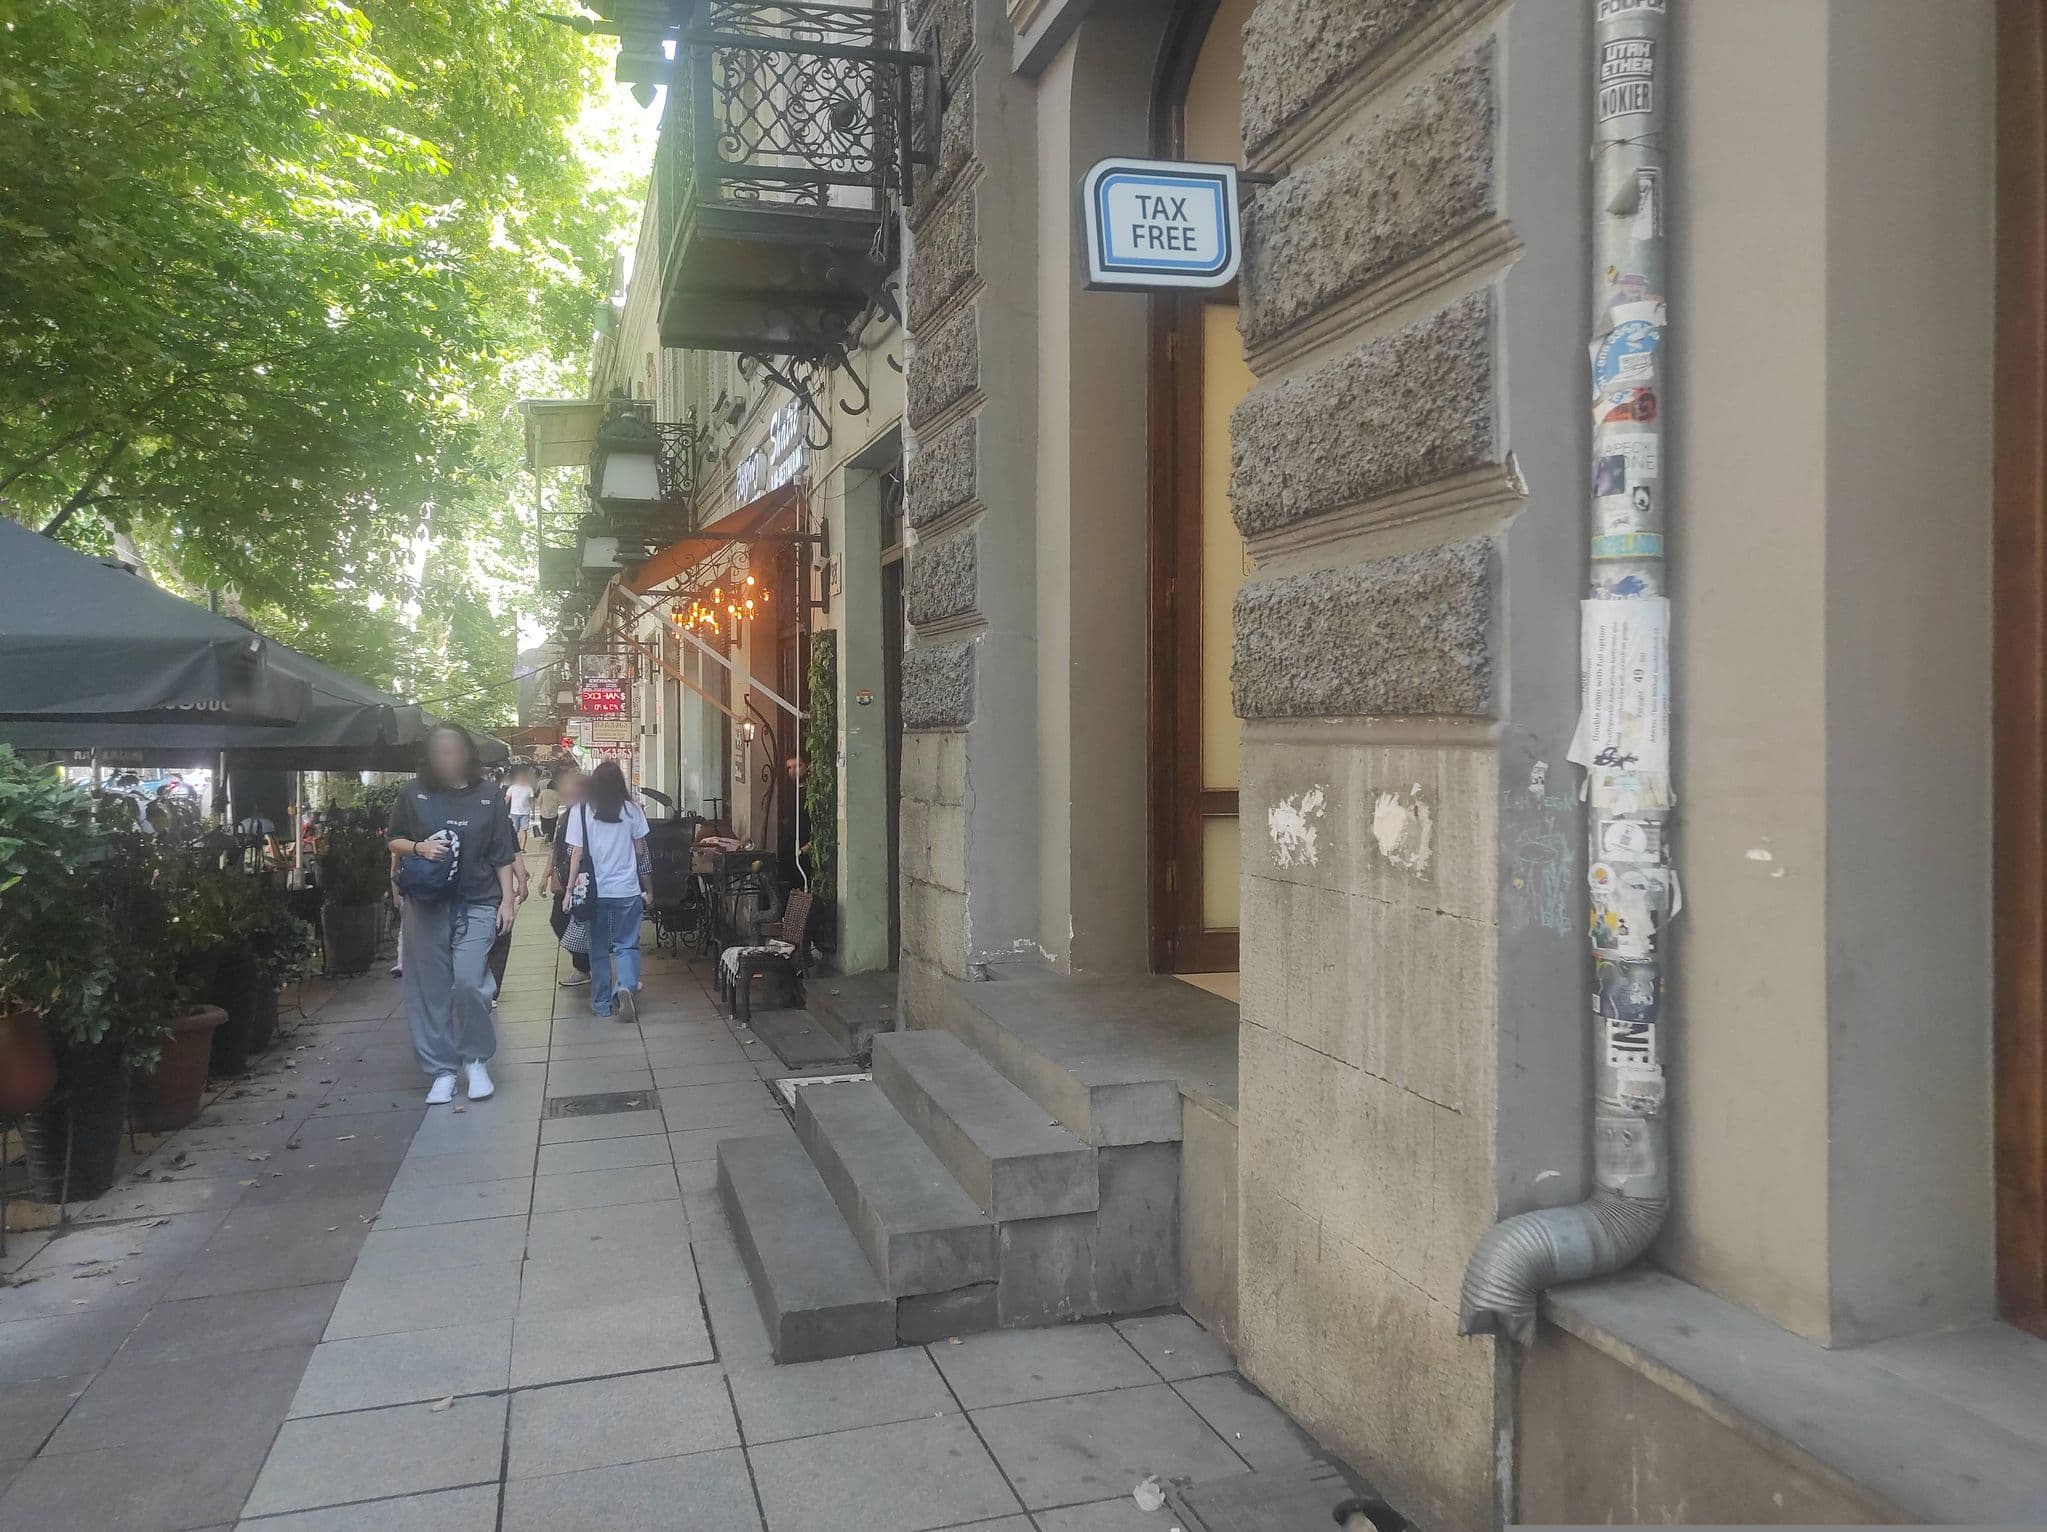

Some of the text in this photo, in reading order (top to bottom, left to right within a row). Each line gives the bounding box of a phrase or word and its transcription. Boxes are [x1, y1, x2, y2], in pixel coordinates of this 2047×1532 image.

[1605, 43, 1651, 61] UTAH
[1601, 58, 1654, 77] ETHER
[1135, 194, 1188, 222] TAX
[1132, 224, 1197, 252] FREE
[1633, 669, 1644, 683] 49
[1592, 712, 1601, 742] Double
